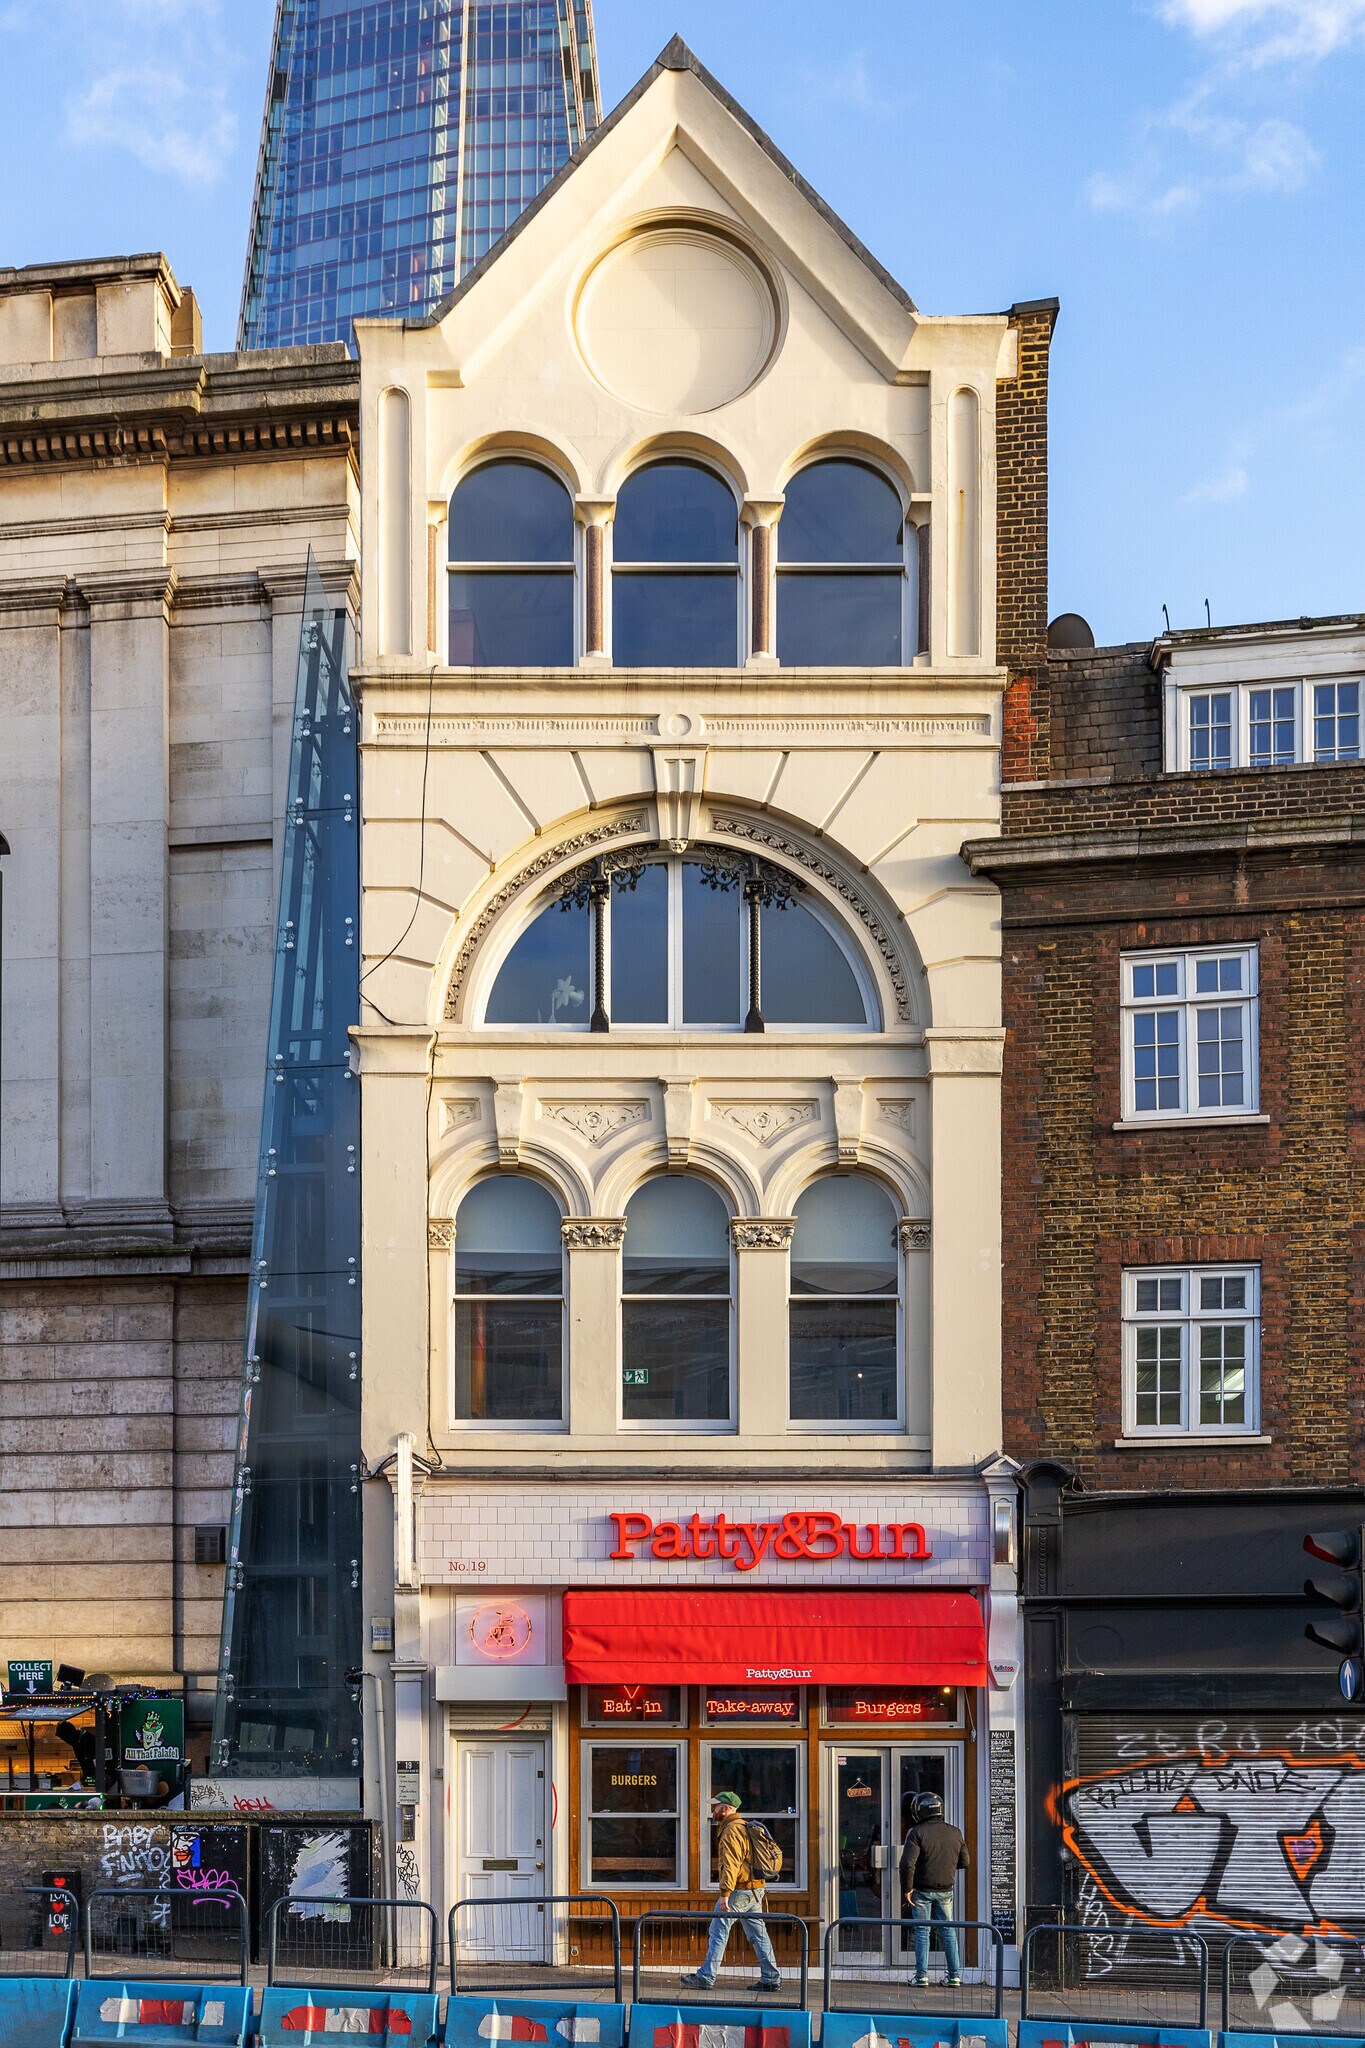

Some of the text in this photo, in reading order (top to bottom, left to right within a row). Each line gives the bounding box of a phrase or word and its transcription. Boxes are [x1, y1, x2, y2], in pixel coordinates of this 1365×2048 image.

[609, 1511, 932, 1571] Patty&Bun
[9, 1663, 52, 1671] COLLECT
[18, 1672, 44, 1681] HERE
[707, 1701, 794, 1715] Take-away
[855, 1701, 921, 1716] Burgers
[991, 1731, 1010, 1739] MENU
[126, 1747, 179, 1759] All That Falafel
[405, 1761, 412, 1770] 19
[611, 1775, 657, 1786] BURGERS
[103, 1824, 161, 1849] BABY
[48, 1913, 69, 1927] LOVE
